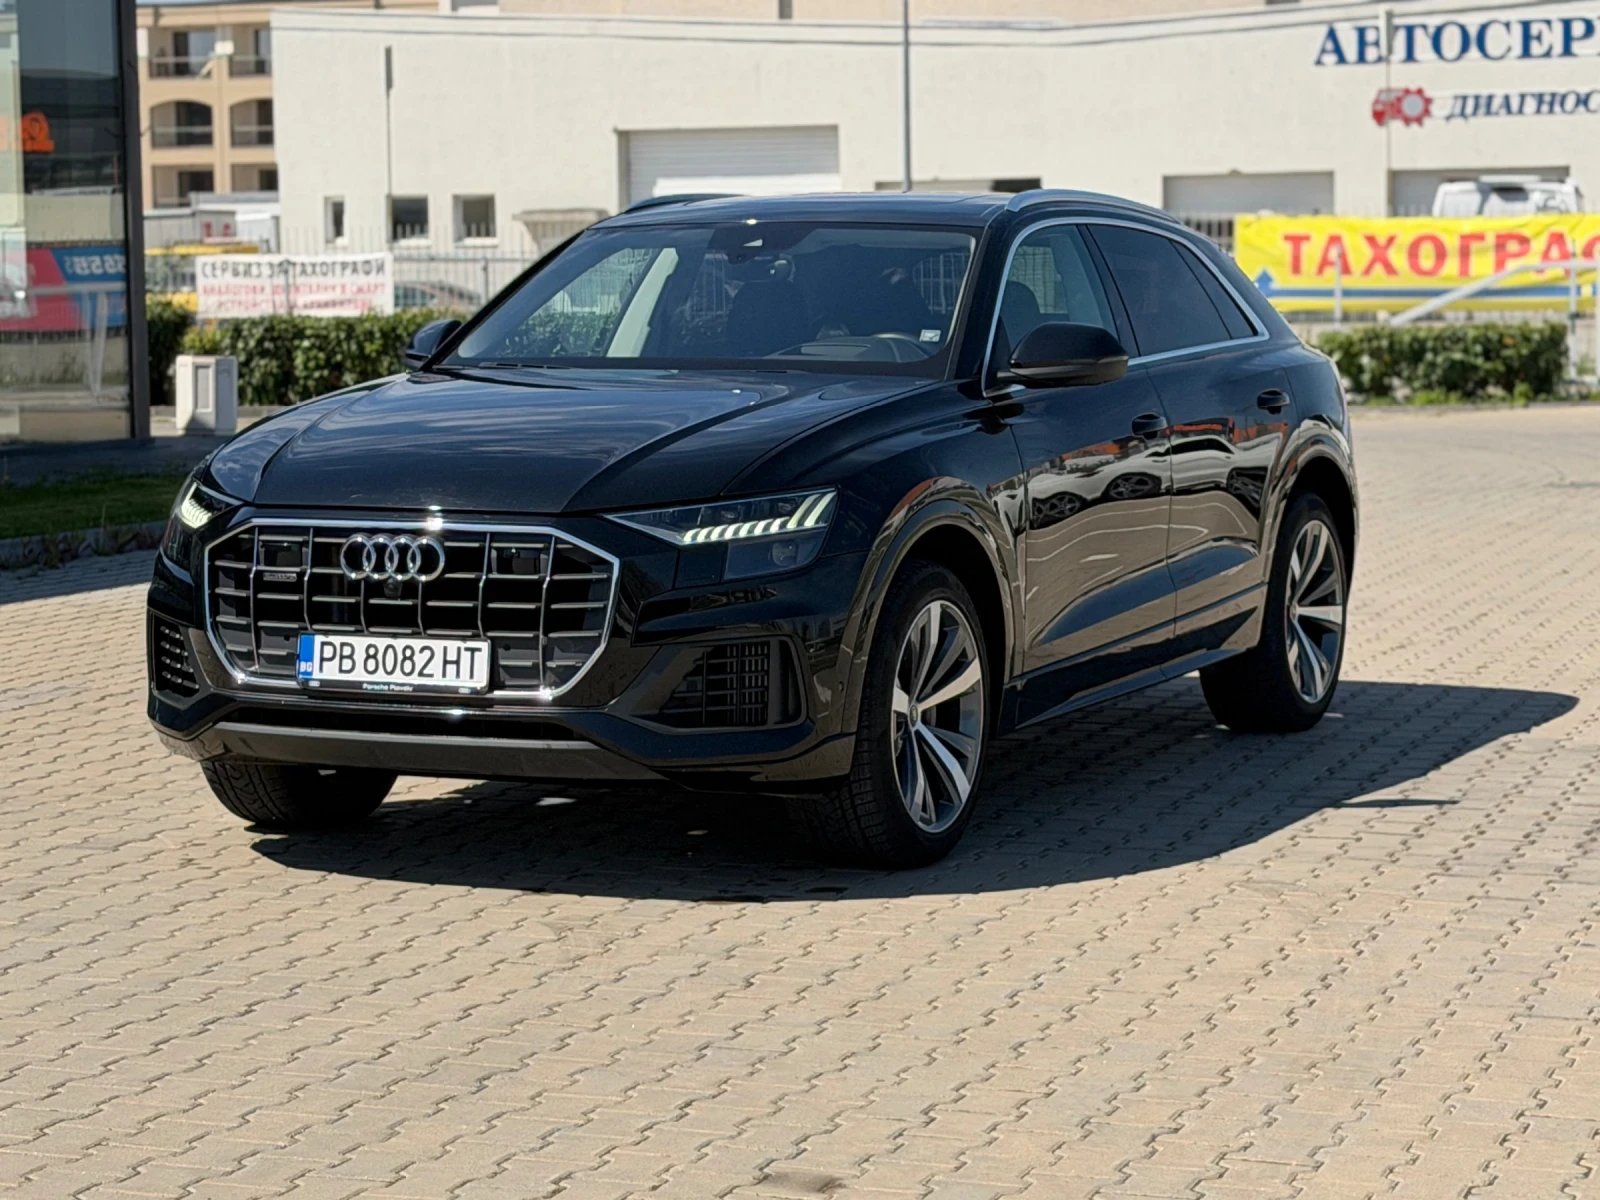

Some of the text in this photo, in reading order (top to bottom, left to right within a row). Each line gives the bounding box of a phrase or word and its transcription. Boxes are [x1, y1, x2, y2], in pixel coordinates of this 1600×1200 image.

[1314, 16, 1600, 66] АВТОСЕР
[1444, 89, 1600, 125] ДИАГНОС
[201, 260, 262, 278] СЕРВИЗ
[300, 661, 313, 672] BG
[319, 641, 482, 680] PB 8082 HT
